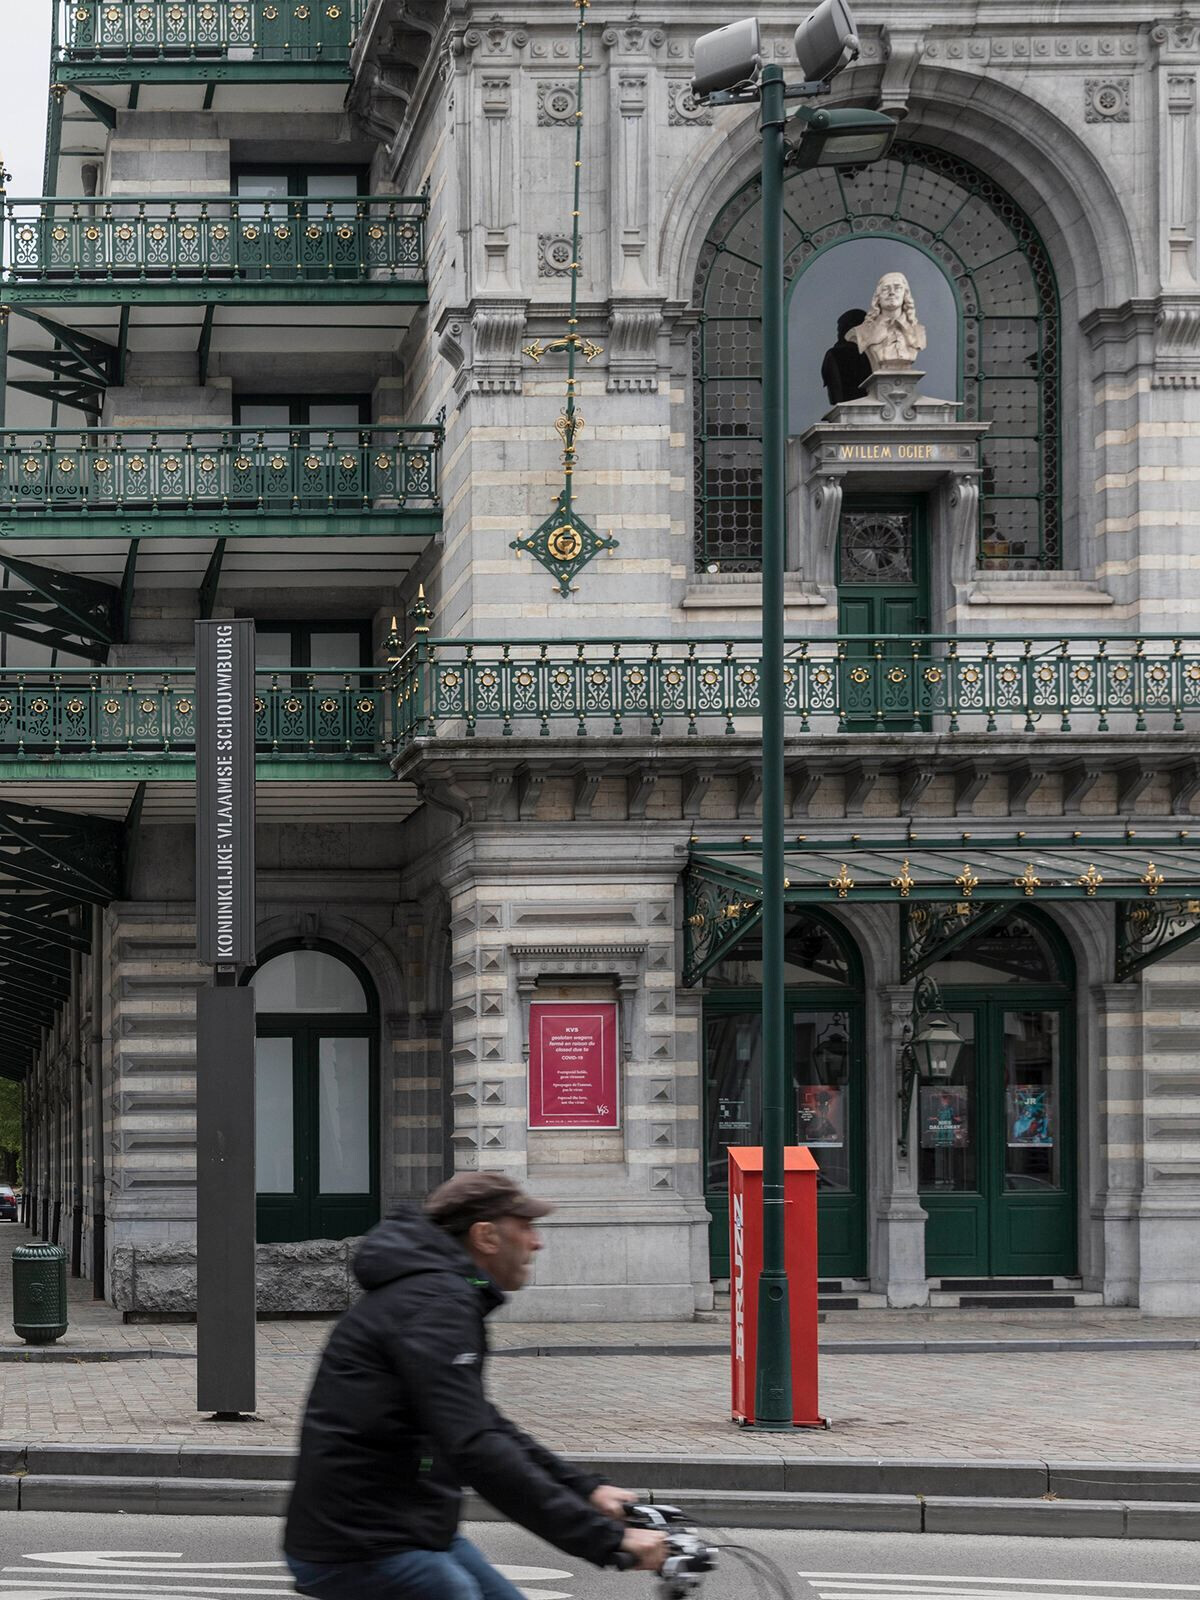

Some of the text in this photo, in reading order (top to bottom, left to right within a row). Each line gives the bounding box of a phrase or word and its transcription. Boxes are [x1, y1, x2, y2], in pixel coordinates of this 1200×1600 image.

[841, 445, 892, 459] WILLEM
[217, 625, 233, 751] SCHOUWBURG
[217, 755, 233, 839] VLAAMSE
[217, 843, 233, 957] KONINKLIJKE
[734, 1193, 744, 1362] BRUZZ
